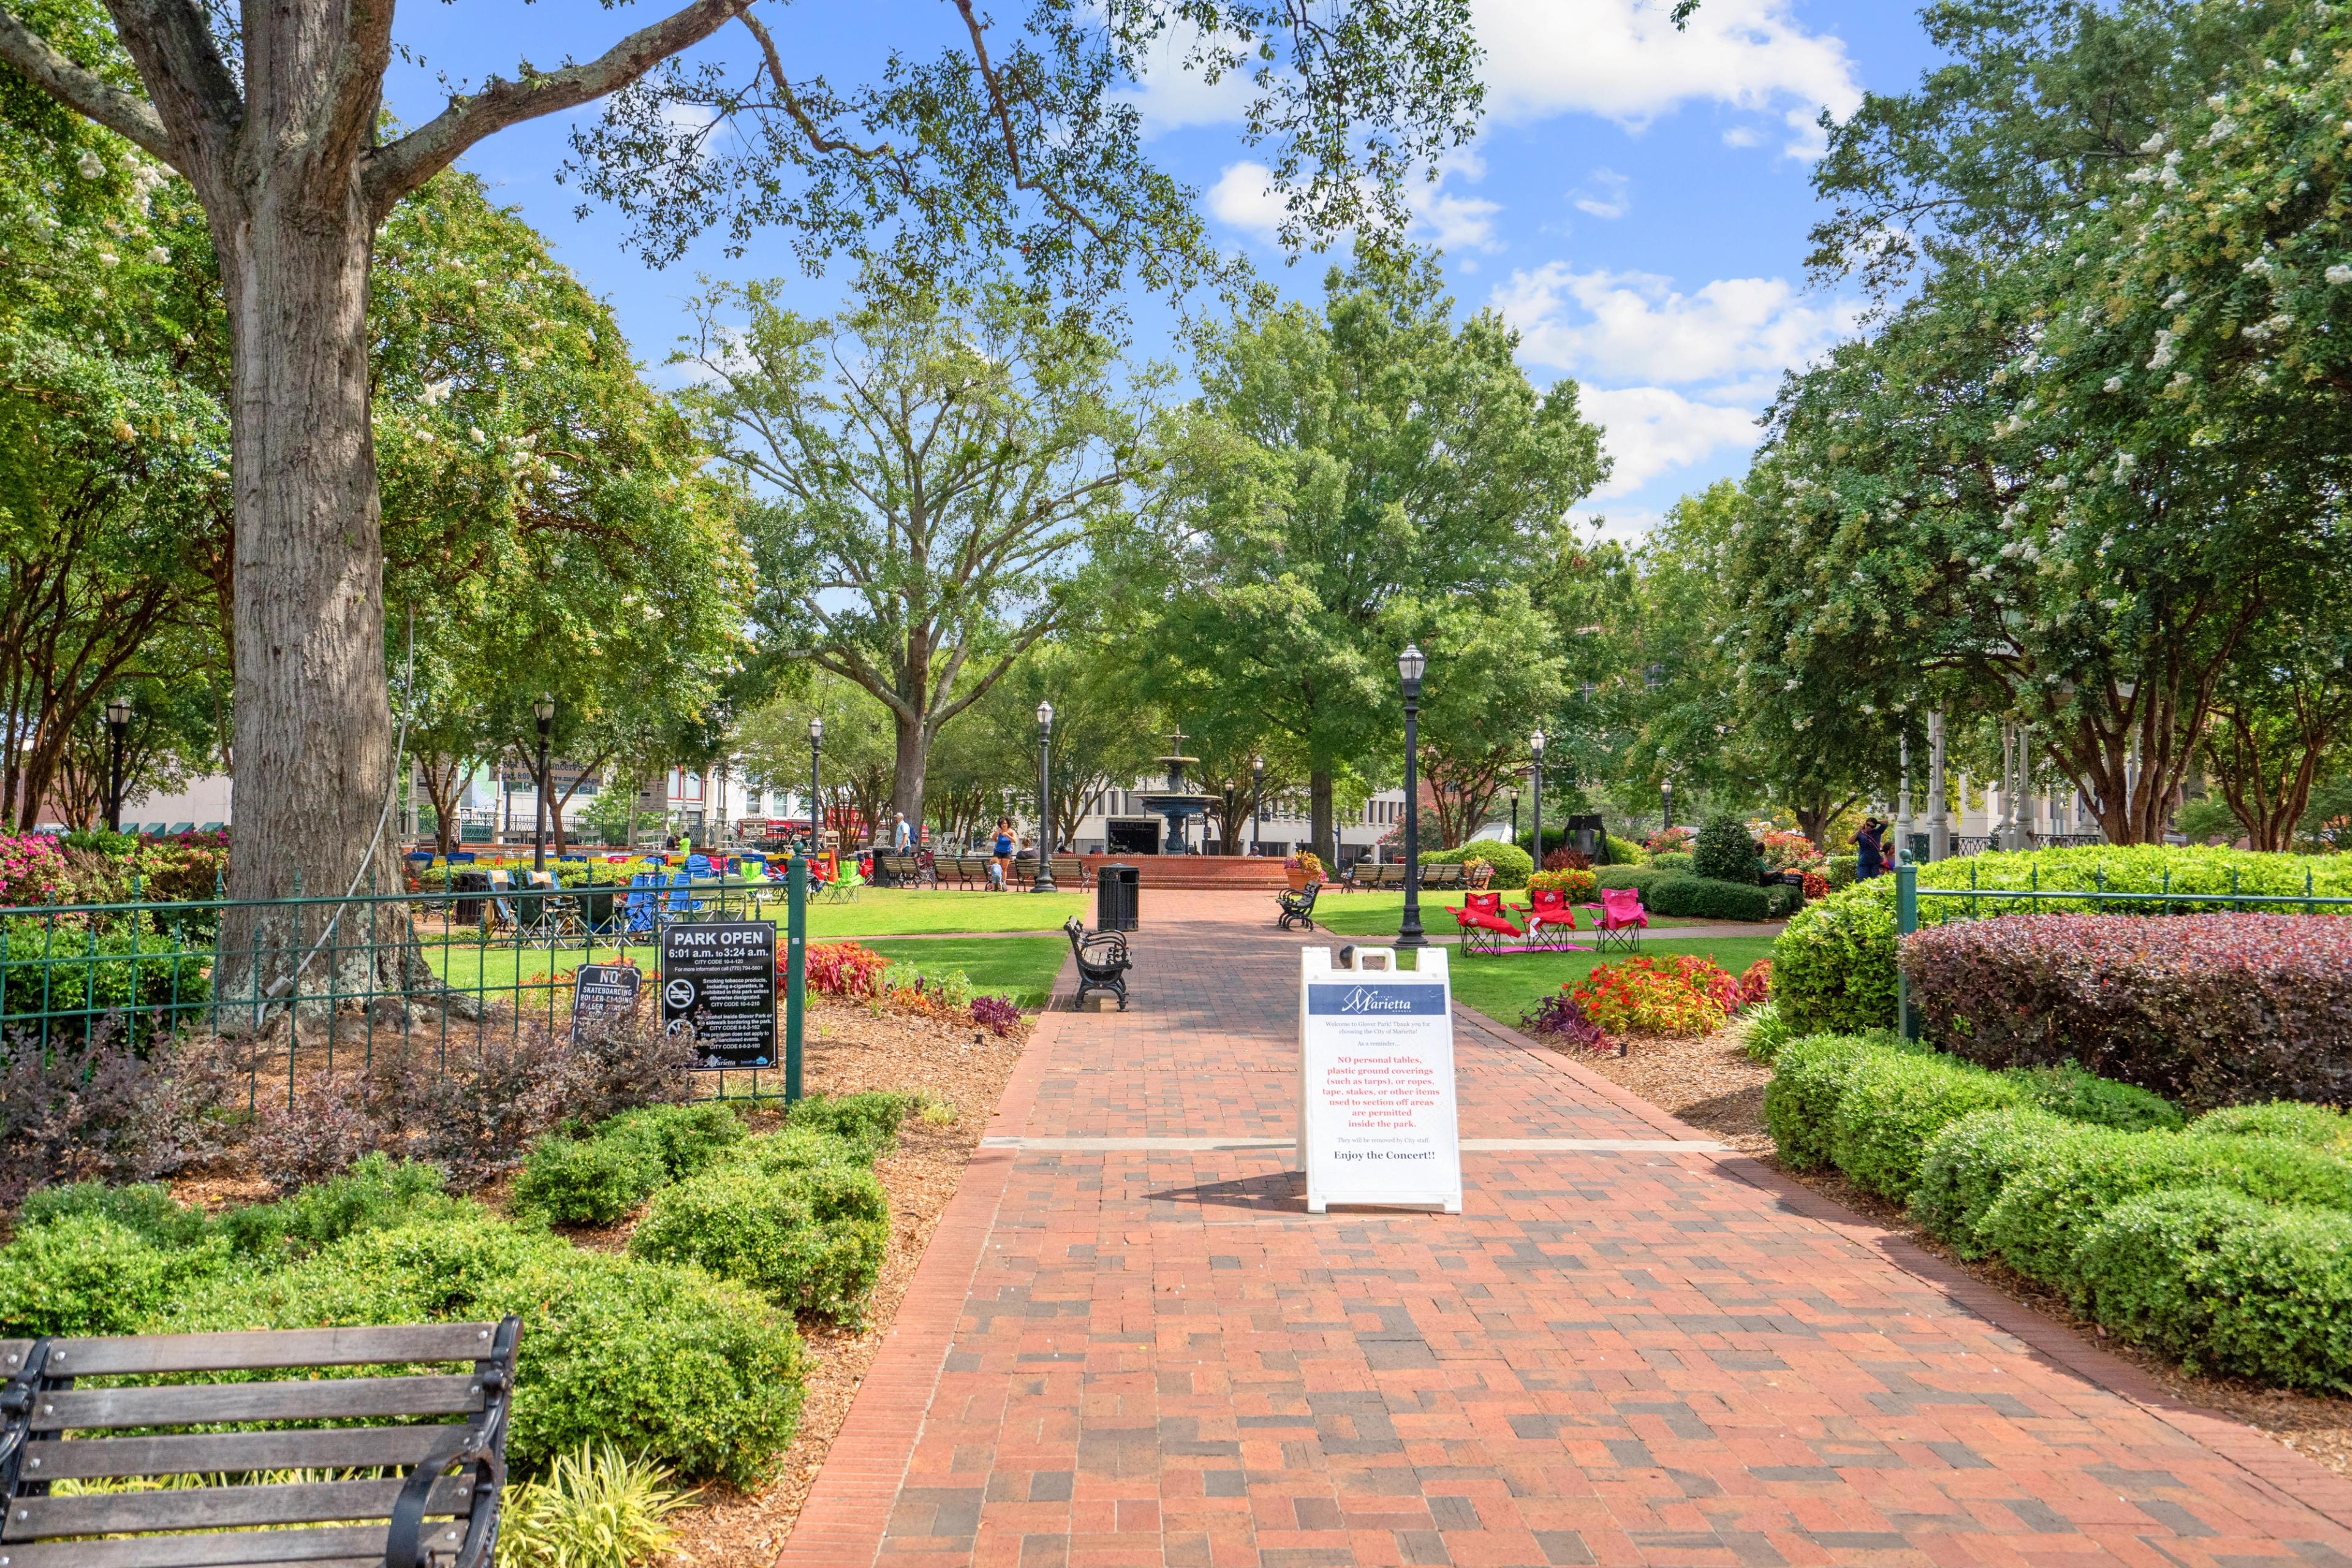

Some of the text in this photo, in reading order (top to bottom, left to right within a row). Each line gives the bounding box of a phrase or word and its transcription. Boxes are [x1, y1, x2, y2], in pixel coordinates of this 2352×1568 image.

[675, 932, 763, 945] PARK OPEN
[669, 949, 689, 958] 6:01
[724, 948, 745, 957] 3:24
[600, 970, 619, 984] NO
[583, 987, 632, 995] SKATEBOARDING
[1341, 989, 1411, 1011] Marietta
[1368, 1109, 1412, 1118] permitted
[1393, 1120, 1416, 1129] park.
[1334, 1151, 1364, 1161] Enjoy
[1367, 1151, 1383, 1159] the
